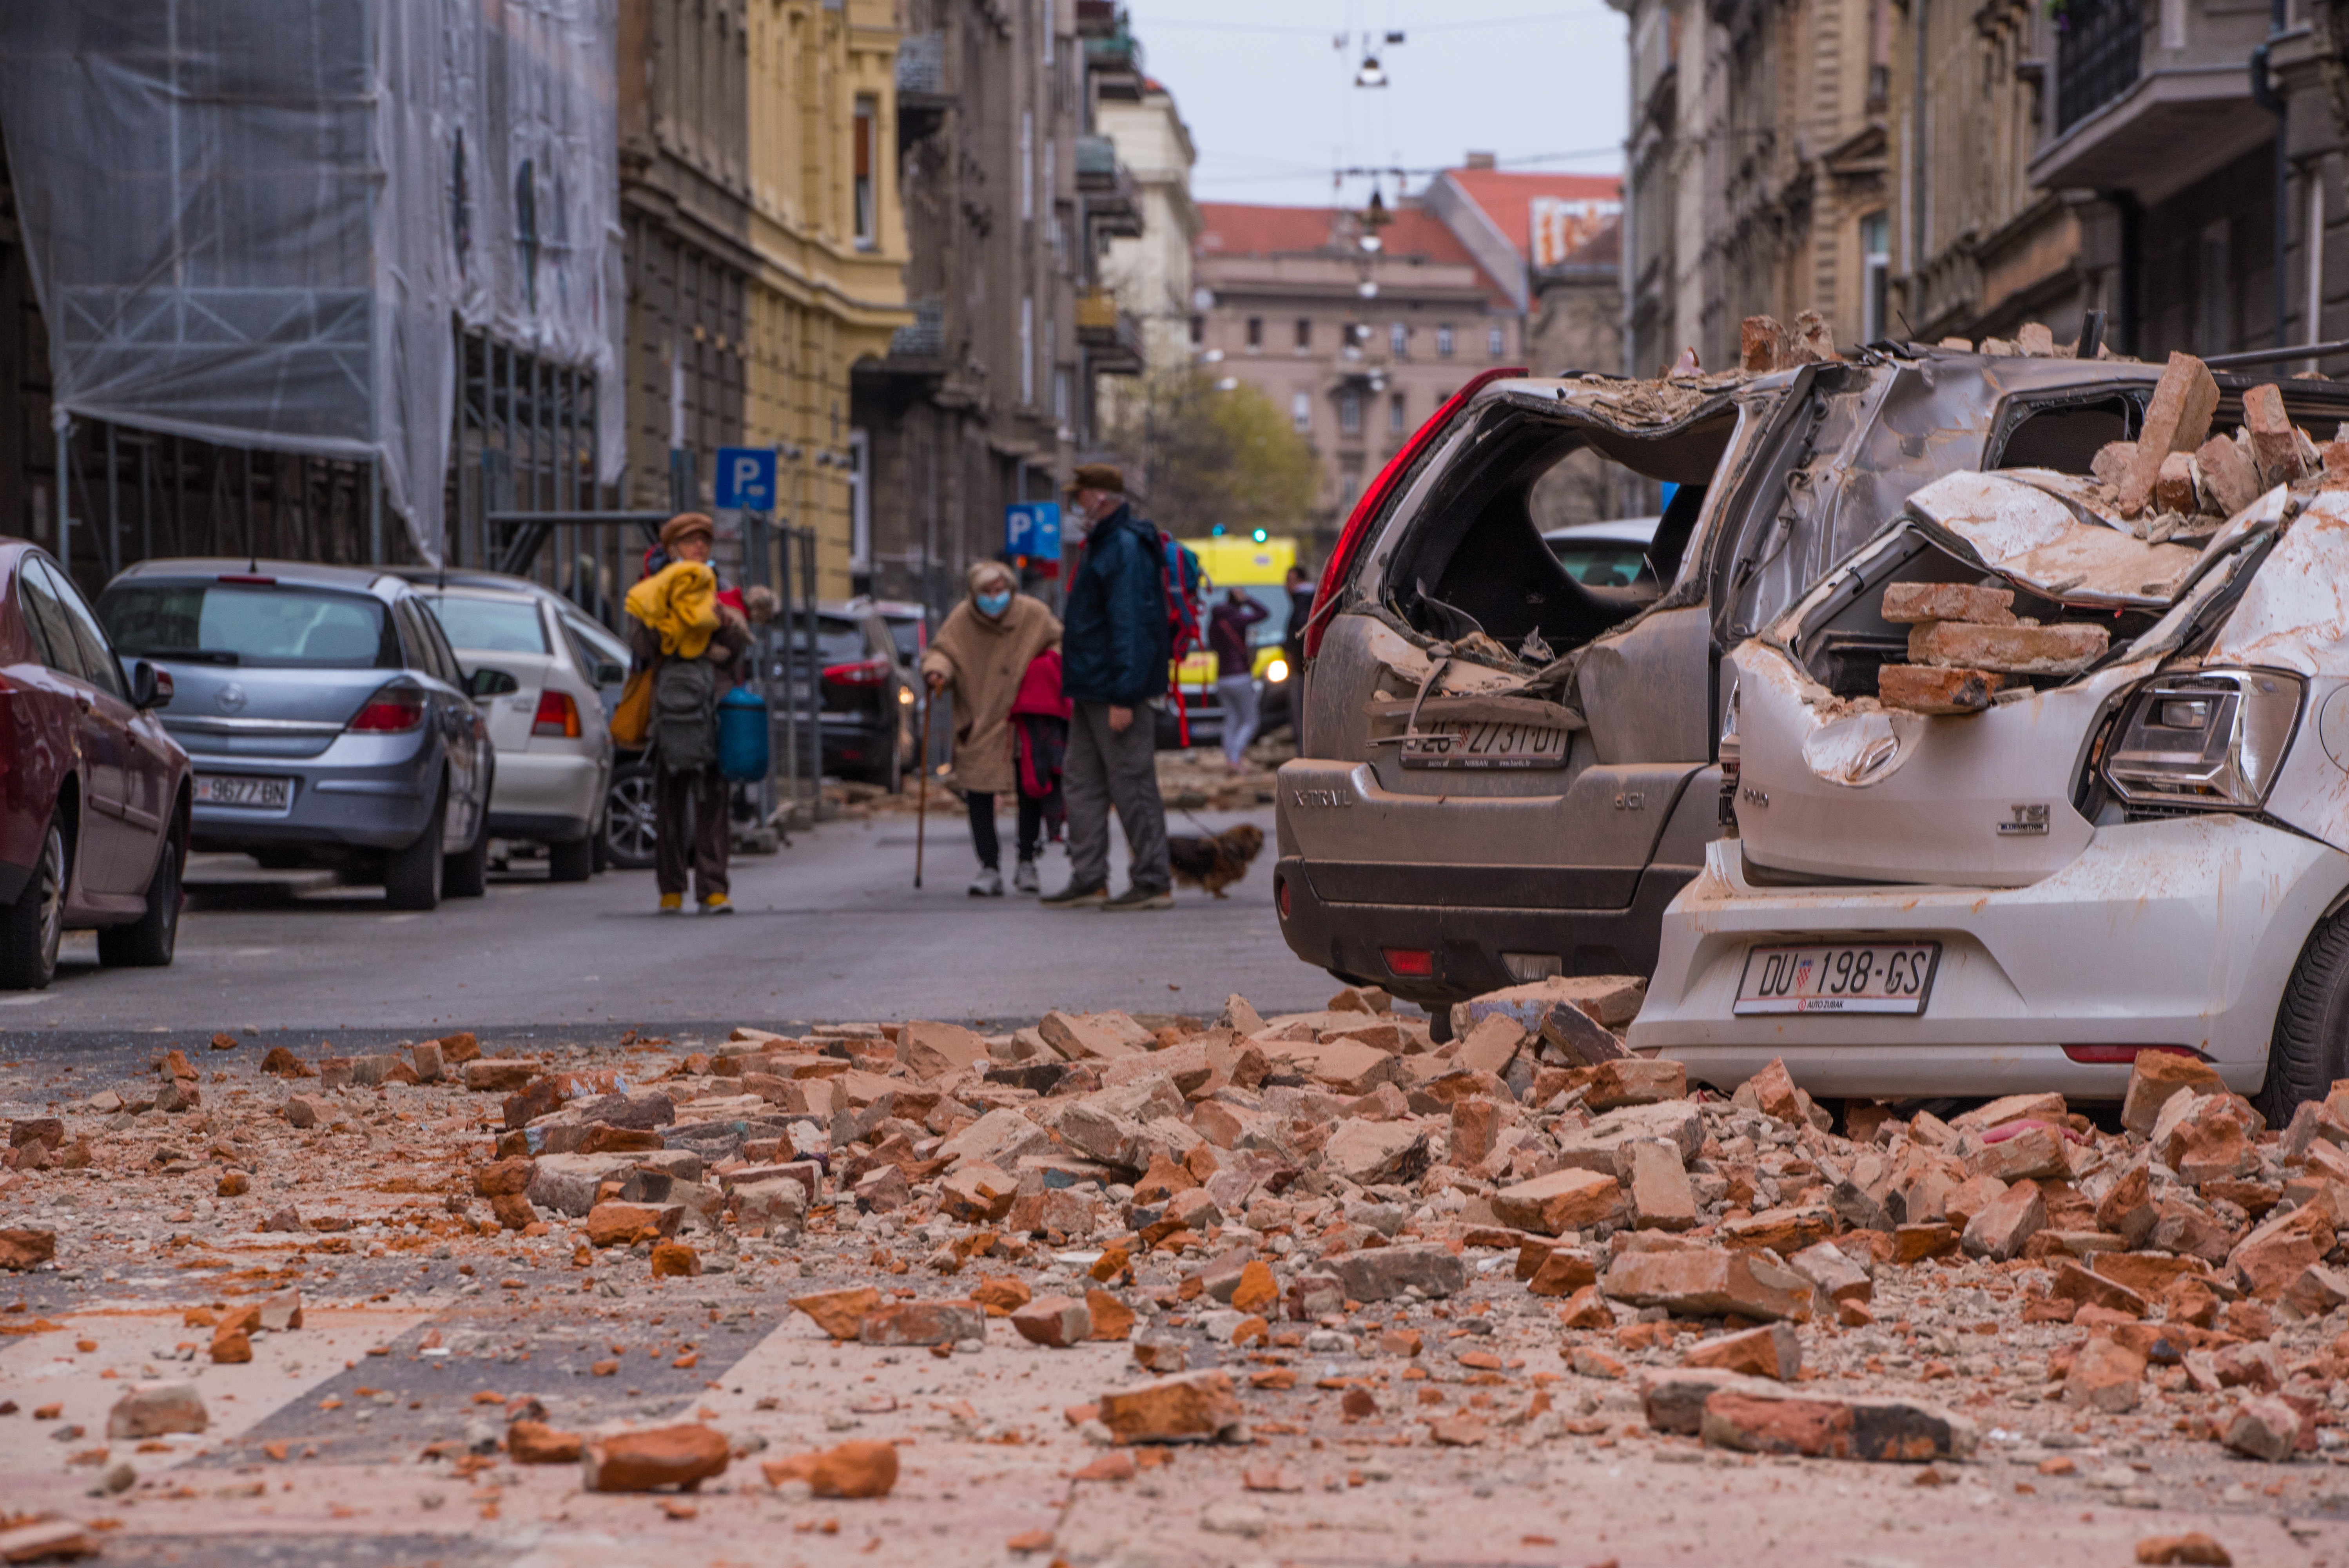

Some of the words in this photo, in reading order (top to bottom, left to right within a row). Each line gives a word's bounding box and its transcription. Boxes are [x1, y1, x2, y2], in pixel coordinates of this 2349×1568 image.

[733, 457, 760, 496] P
[1009, 512, 1032, 545] P
[1293, 789, 1352, 807] X-TRAIL
[1743, 787, 1769, 808] POLO
[2011, 804, 2050, 823] TSI
[1758, 953, 1798, 996] DU
[1817, 951, 1926, 994] 198-GS
[1807, 1000, 1823, 1009] AUTO
[1823, 999, 1844, 1009] ZUBAK
